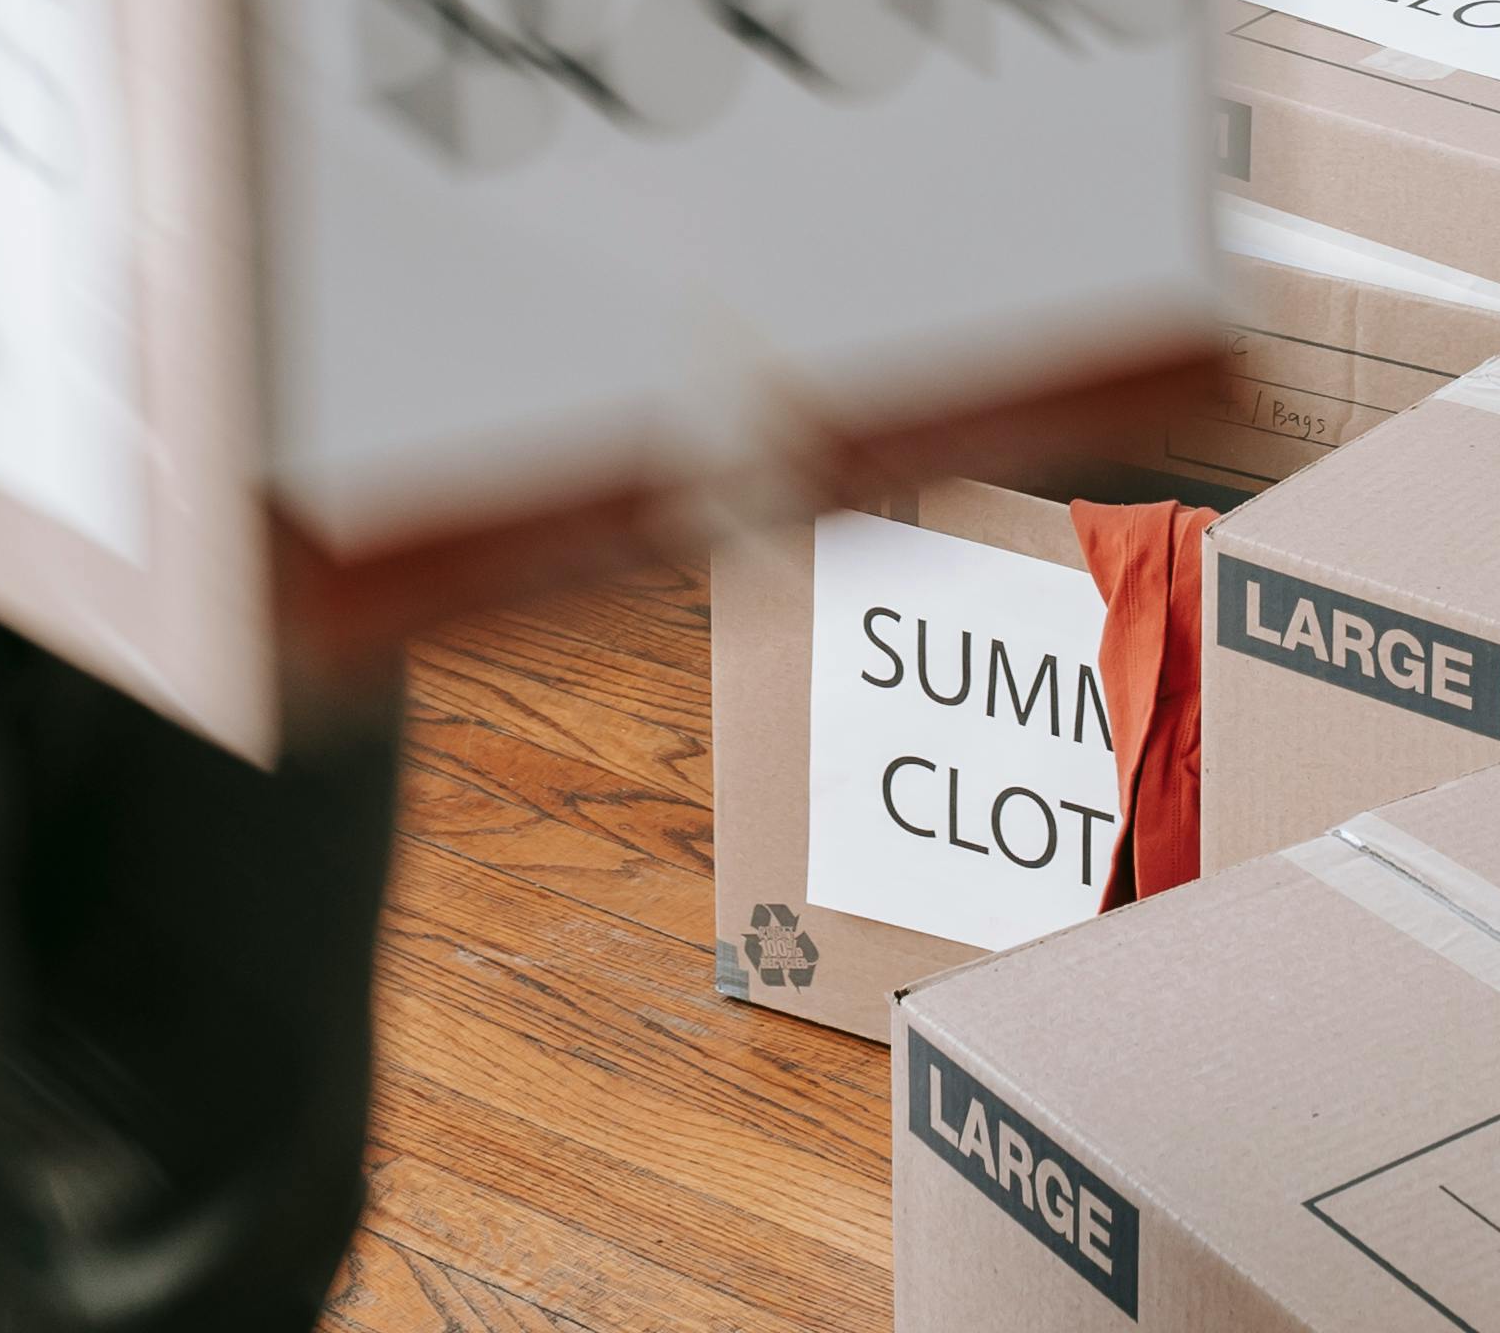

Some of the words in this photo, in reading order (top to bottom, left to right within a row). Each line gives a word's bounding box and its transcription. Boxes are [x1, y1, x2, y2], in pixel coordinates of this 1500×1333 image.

[1273, 400, 1325, 438] Bags
[1246, 581, 1473, 711] LARGE
[882, 756, 1115, 886] CLOT
[929, 1064, 1113, 1276] LARGE
